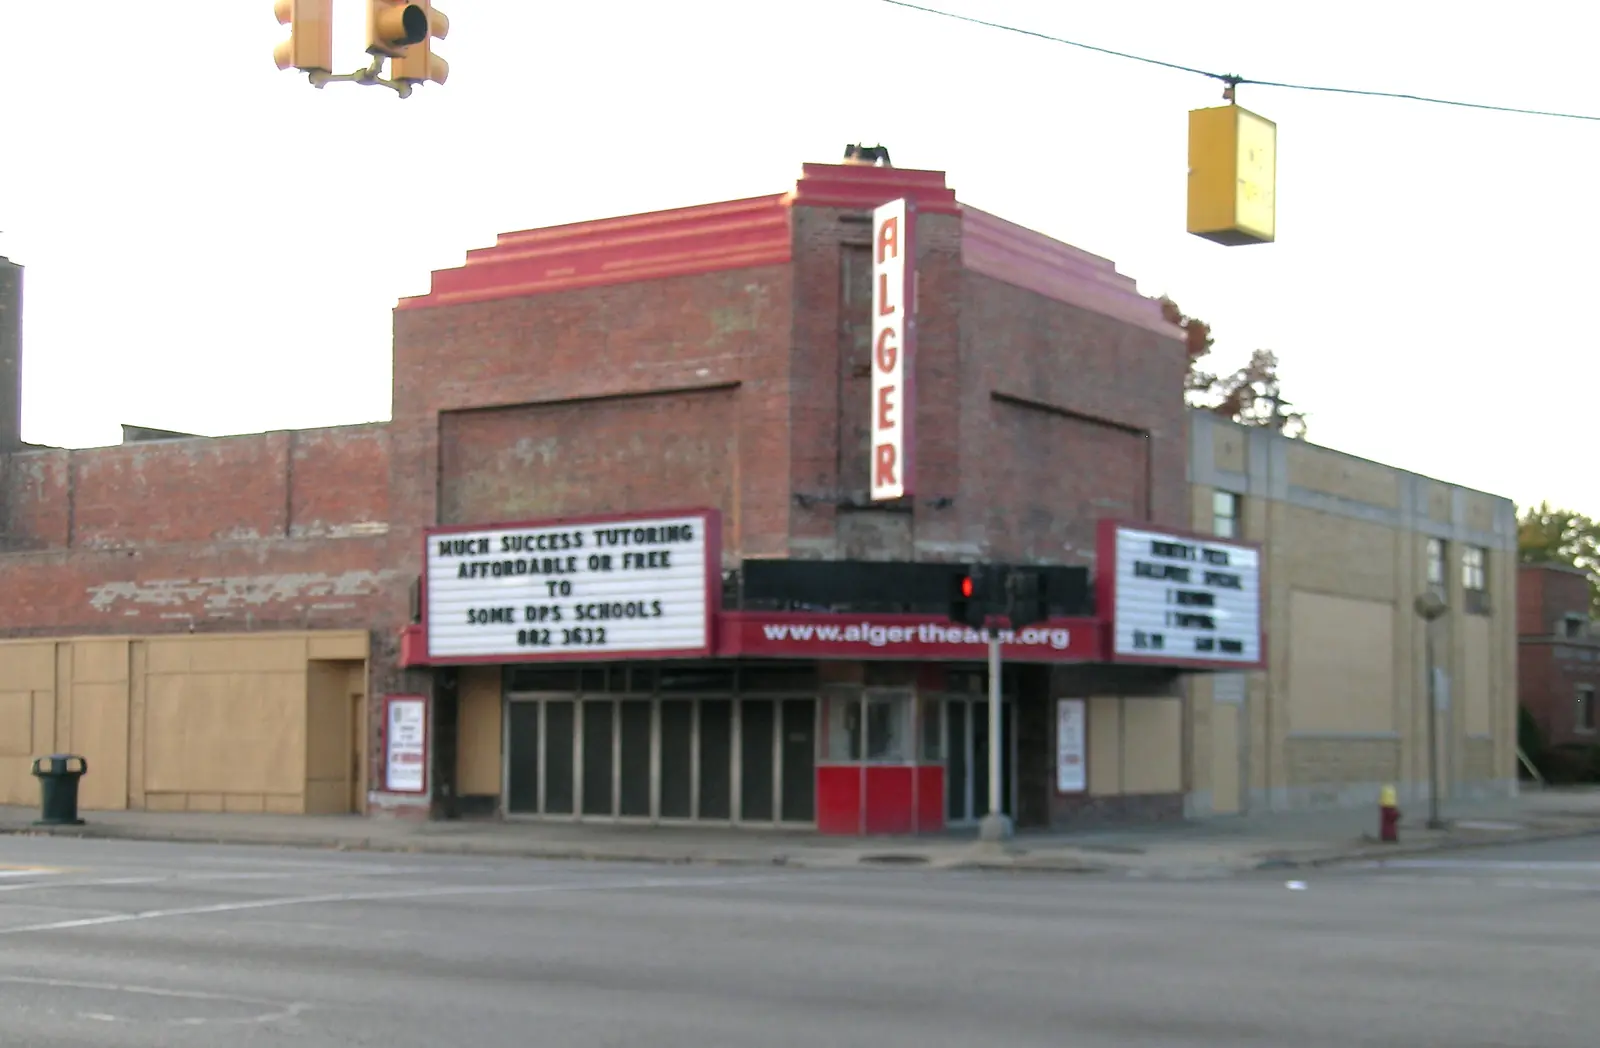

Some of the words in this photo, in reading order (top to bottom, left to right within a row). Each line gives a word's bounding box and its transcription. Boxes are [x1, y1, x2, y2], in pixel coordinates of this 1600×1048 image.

[876, 216, 898, 488] ALGER
[439, 538, 490, 557] MUCH
[501, 531, 583, 553] SUCCESS
[595, 525, 693, 547] TUTORING
[458, 557, 577, 579] AFFORDABLE
[588, 554, 612, 571] OR
[623, 551, 671, 570] FREE
[547, 580, 571, 597] TO
[467, 608, 514, 625] SOME
[525, 605, 561, 621] DPS
[576, 601, 662, 620] SCHOOLS
